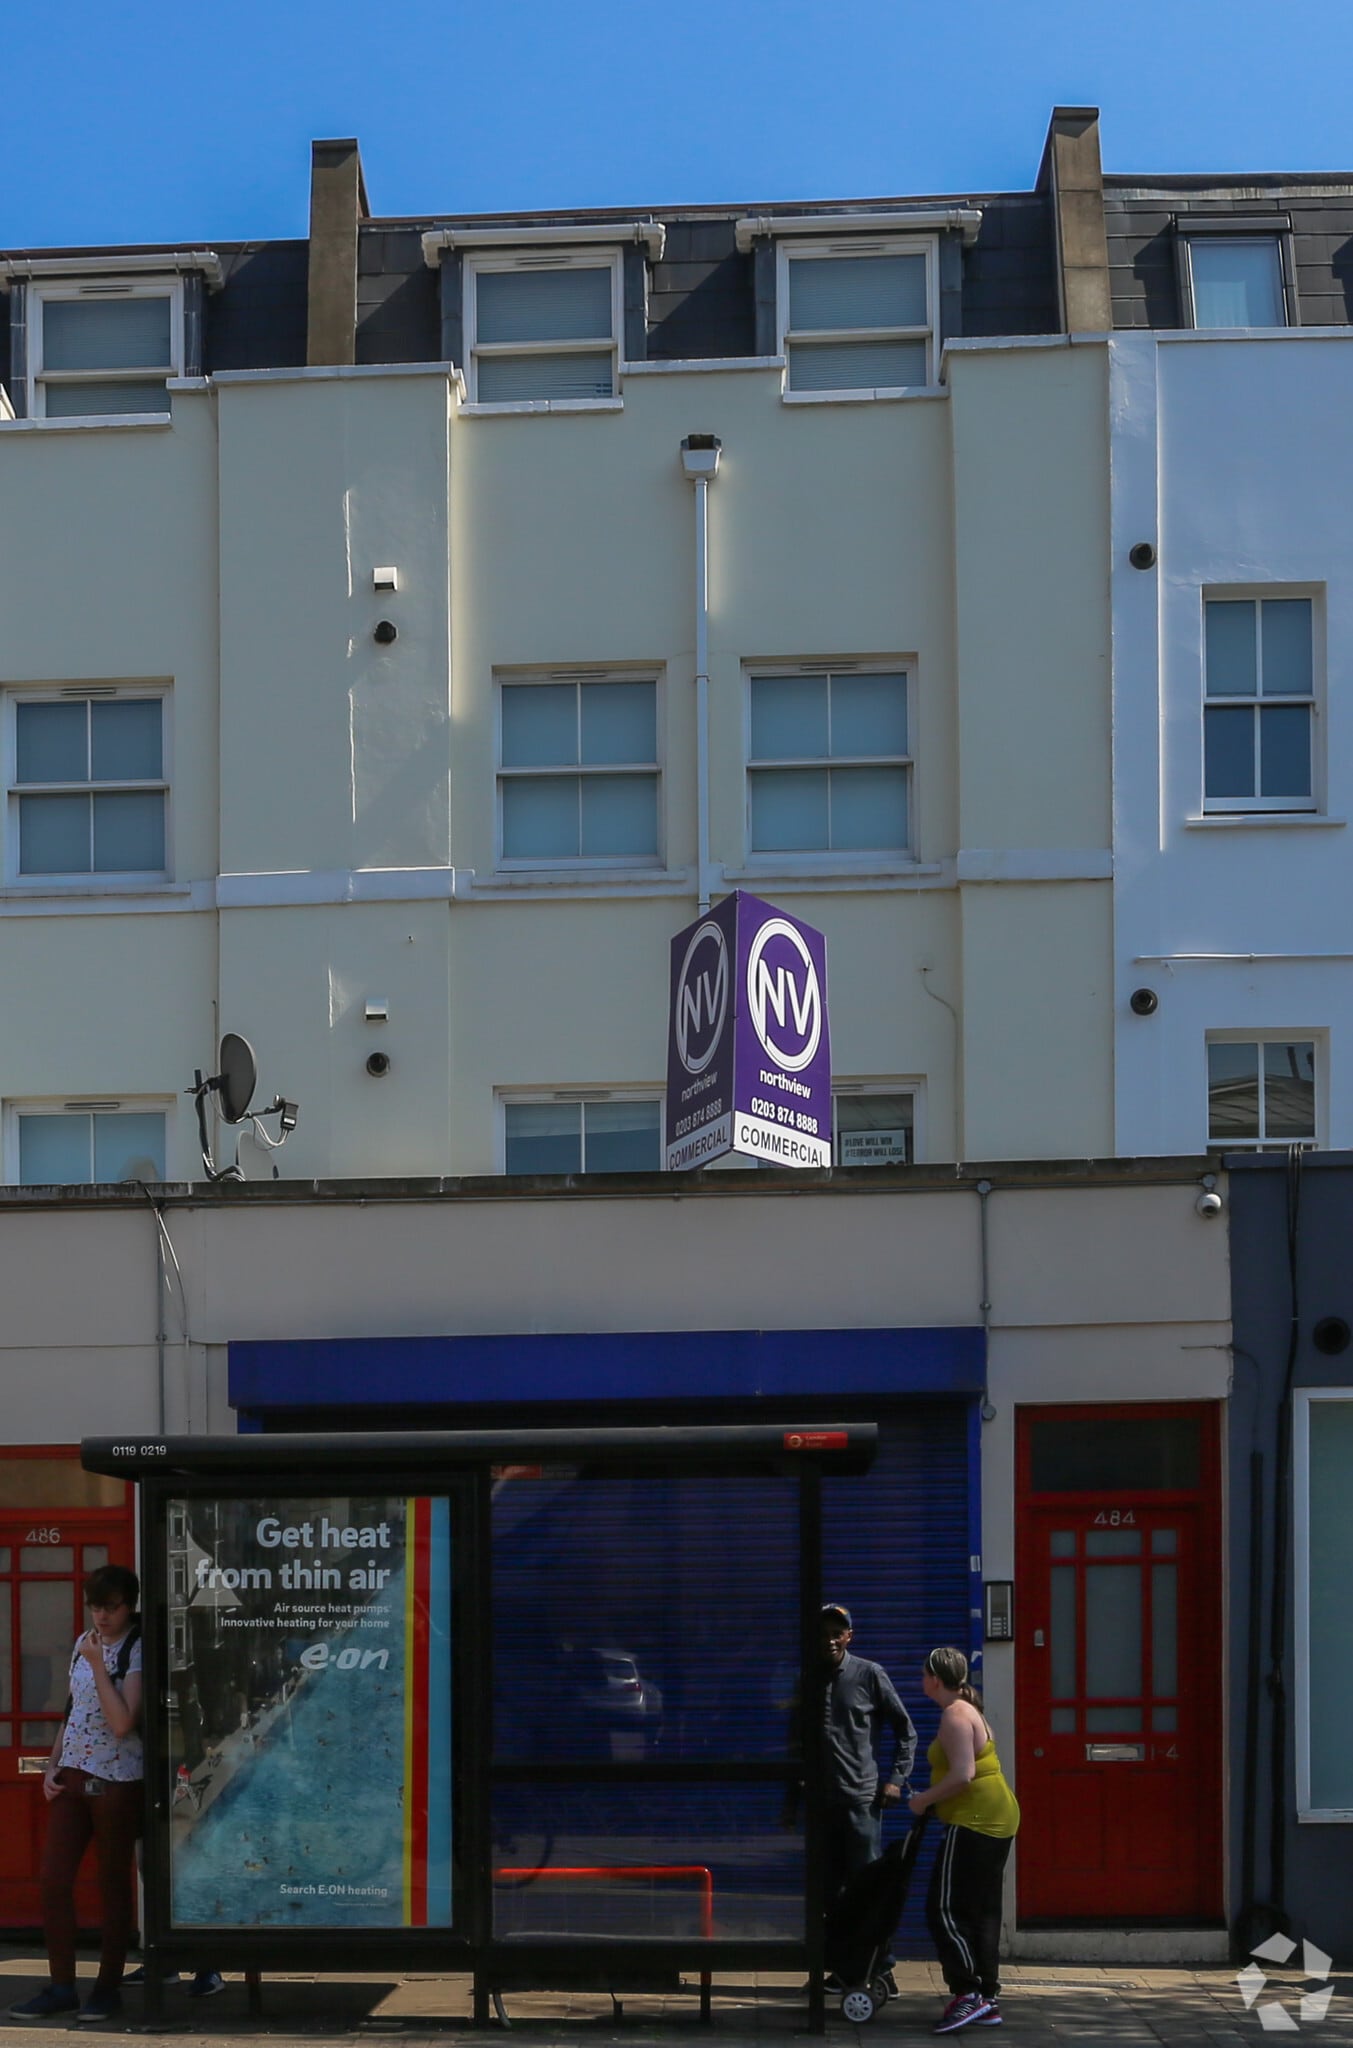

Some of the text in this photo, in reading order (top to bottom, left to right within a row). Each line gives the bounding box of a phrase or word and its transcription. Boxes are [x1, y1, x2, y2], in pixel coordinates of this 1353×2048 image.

[753, 950, 818, 1050] NV
[681, 1071, 718, 1102] northview
[760, 1069, 811, 1099] northview
[675, 1098, 722, 1137] 0203 874 8888
[751, 1097, 818, 1134] 0203 874 8888
[669, 1126, 728, 1170] COMMERCIAL
[112, 1445, 167, 1456] 0119 0219
[256, 1517, 391, 1548] Get heat
[1093, 1510, 1136, 1526] 484
[25, 1528, 61, 1544] 486
[195, 1559, 391, 1590] from thin air
[274, 1602, 289, 1613] Air
[292, 1604, 326, 1613] source
[328, 1602, 351, 1613] heat
[221, 1617, 390, 1630] Innovative heating for your home
[280, 1883, 389, 1898] Search E.ON heating
